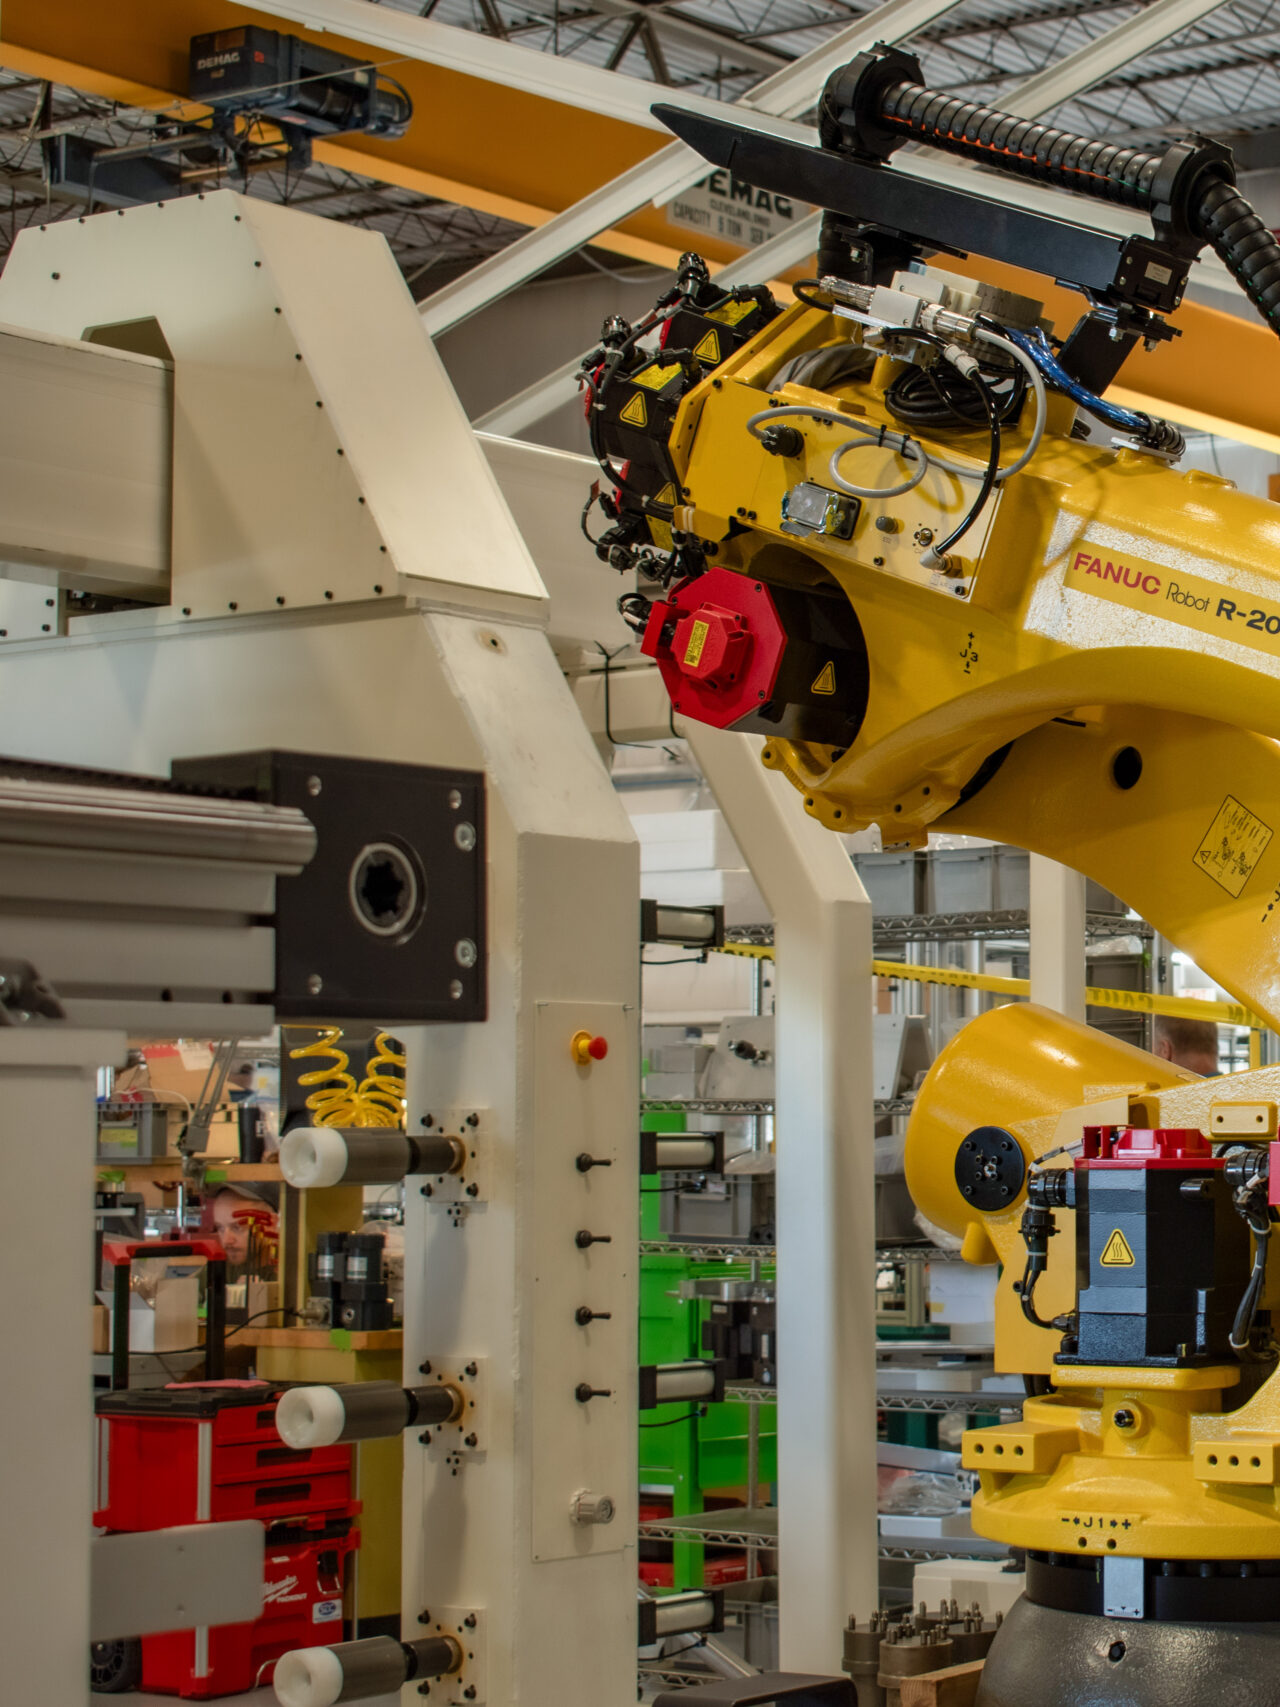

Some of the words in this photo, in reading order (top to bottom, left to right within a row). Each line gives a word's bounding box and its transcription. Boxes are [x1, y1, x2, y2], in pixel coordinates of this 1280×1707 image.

[197, 52, 240, 70] DEMAG
[693, 169, 792, 219] EMAG
[674, 202, 711, 228] CAPACITY
[1073, 552, 1161, 595] FANUC
[1166, 582, 1211, 612] Robot
